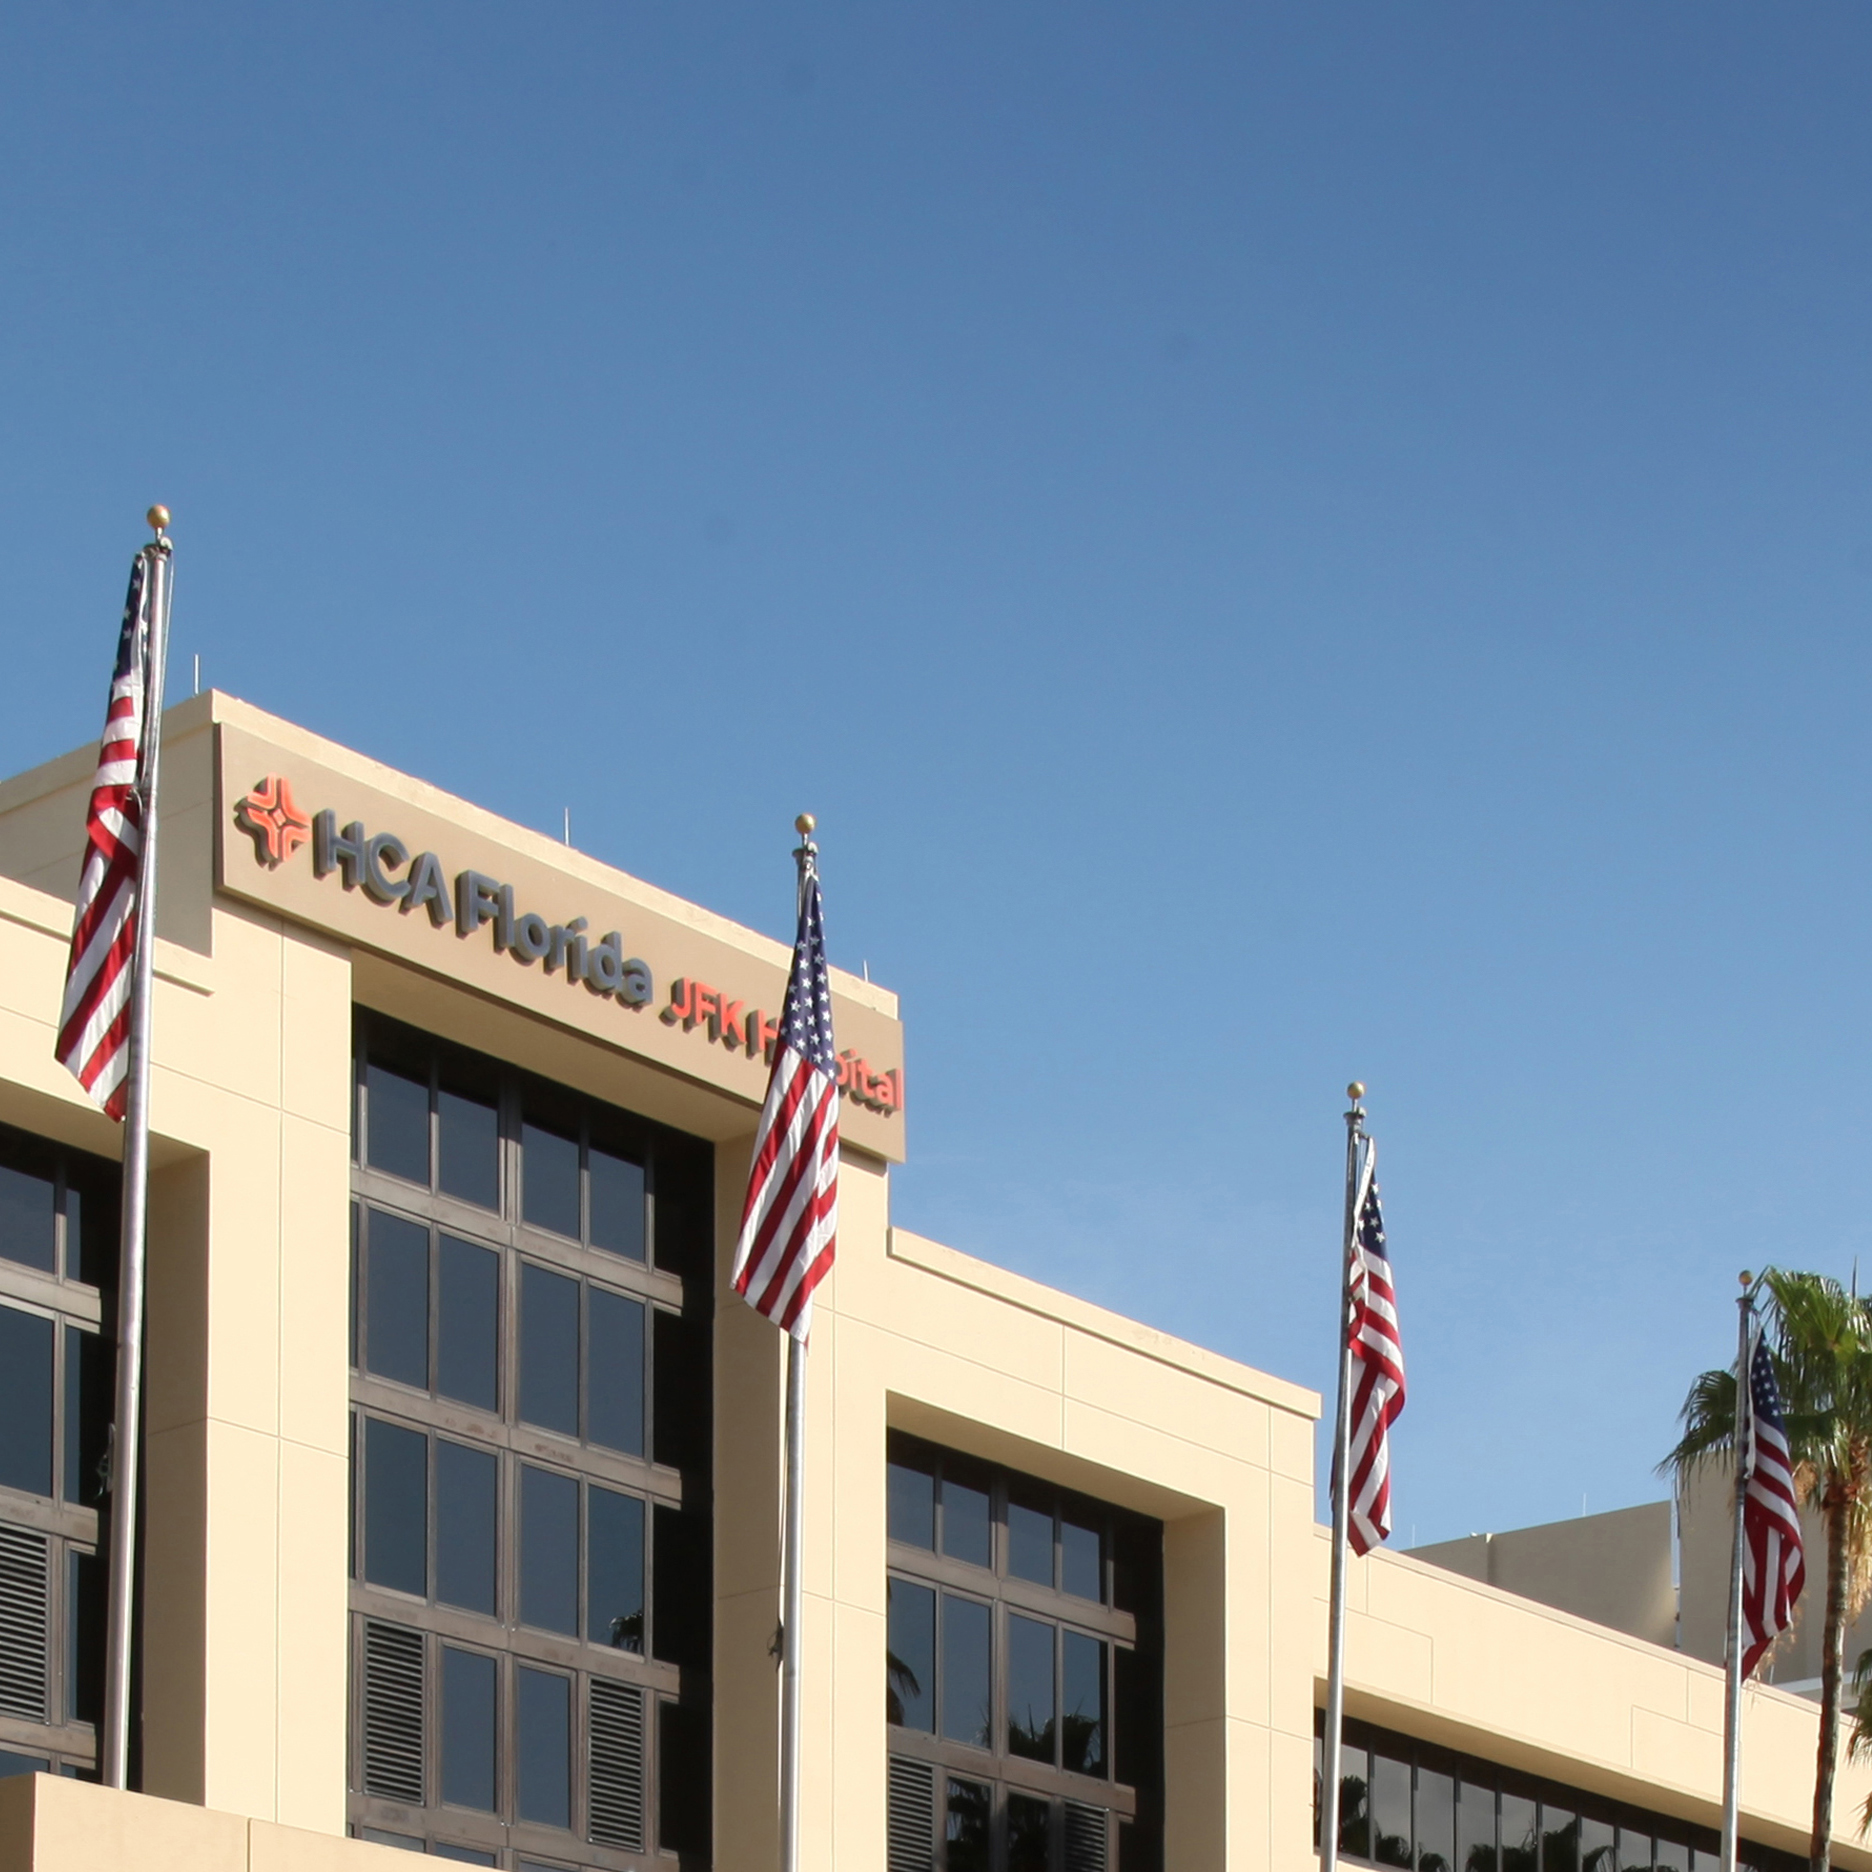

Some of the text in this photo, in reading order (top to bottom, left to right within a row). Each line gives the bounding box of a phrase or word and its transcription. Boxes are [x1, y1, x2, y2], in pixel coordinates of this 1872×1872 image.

[313, 808, 902, 1116] HCA Florida JFK Hpital
